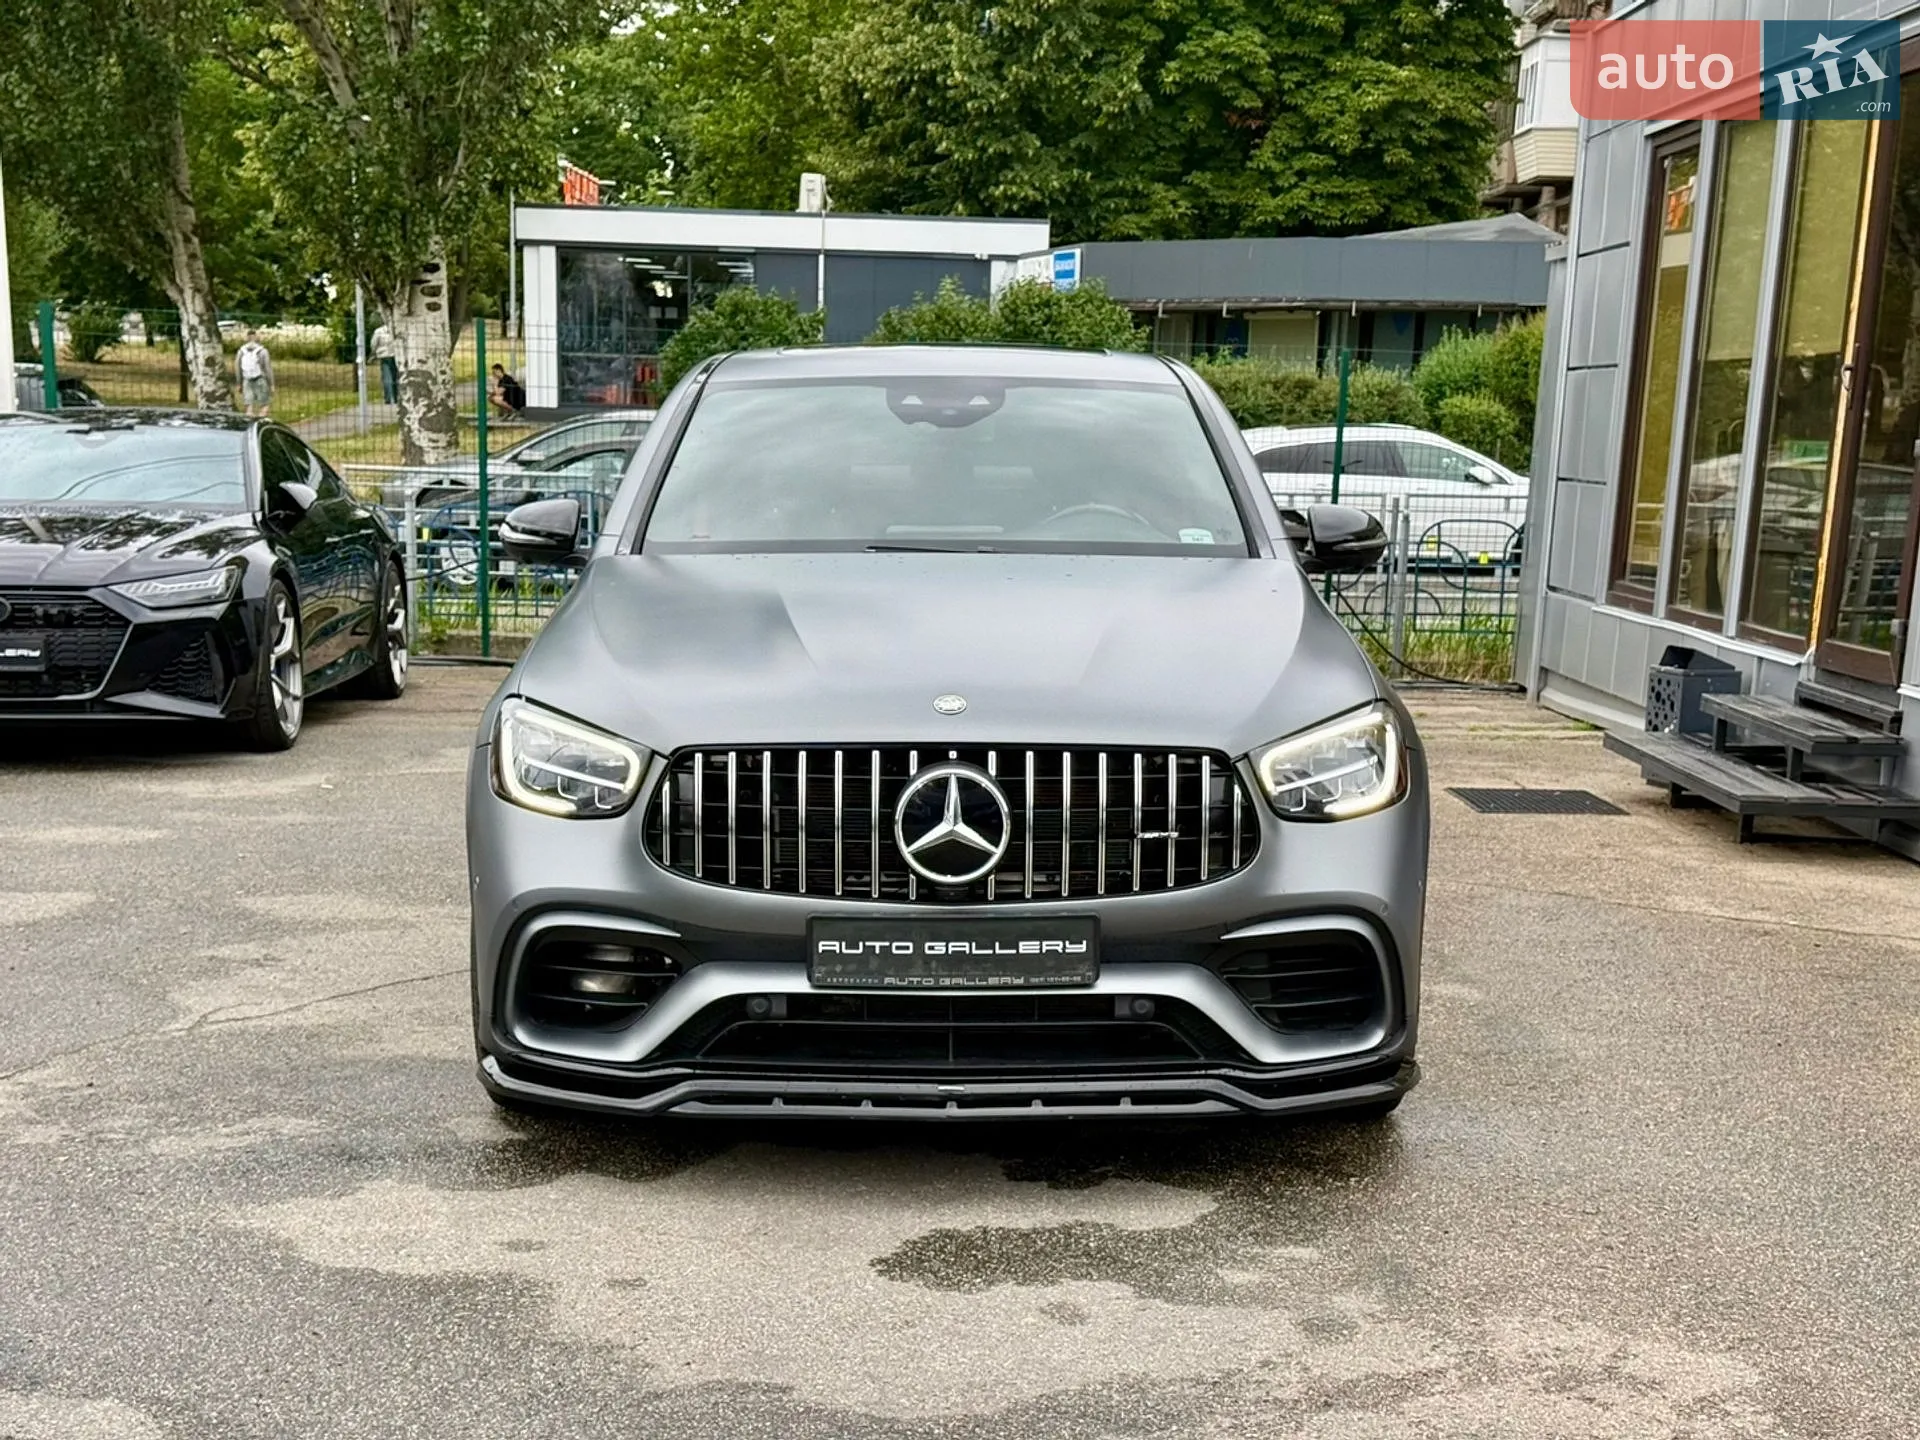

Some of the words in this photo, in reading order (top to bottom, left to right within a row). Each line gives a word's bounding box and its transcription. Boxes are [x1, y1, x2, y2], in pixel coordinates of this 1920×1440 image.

[818, 940, 914, 955] AUTO
[924, 939, 1087, 955] GALLERY
[883, 976, 935, 986] AUTO
[939, 976, 1025, 986] GALLERY
